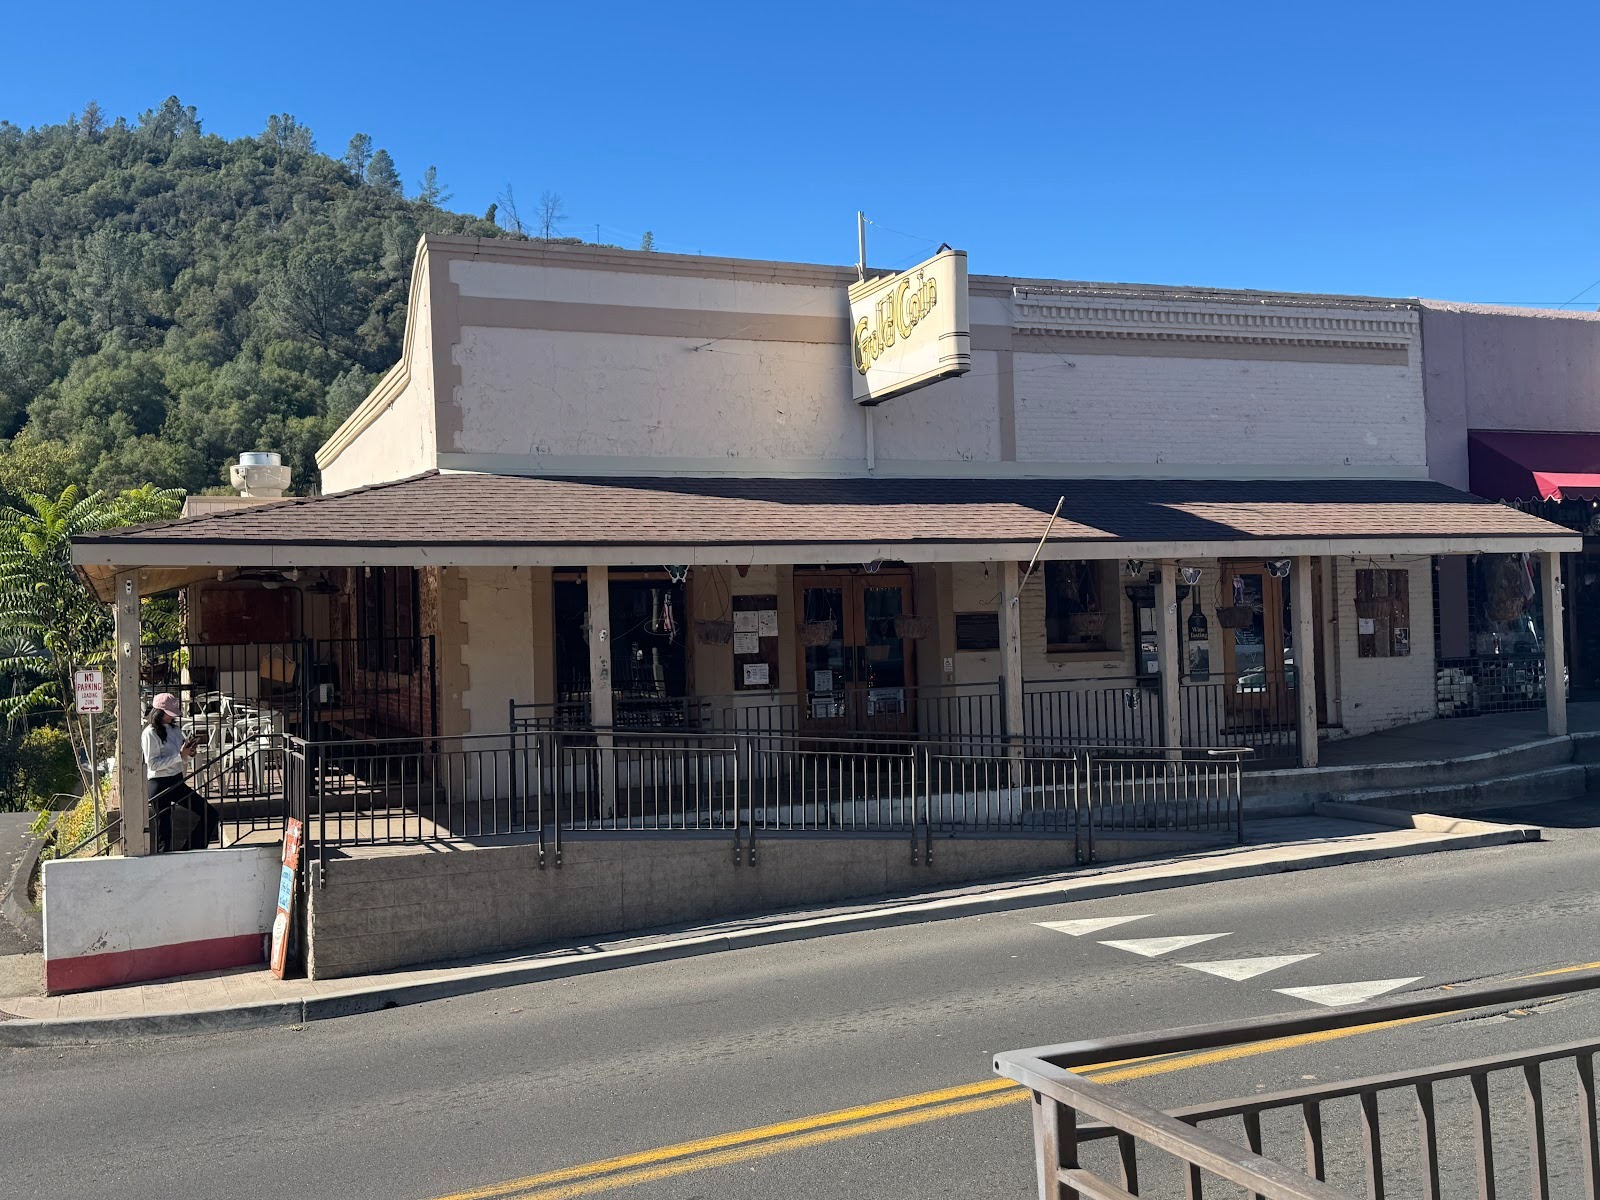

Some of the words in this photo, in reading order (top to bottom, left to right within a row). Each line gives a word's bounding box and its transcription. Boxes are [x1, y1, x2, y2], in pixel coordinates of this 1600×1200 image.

[853, 289, 895, 375] Gold
[896, 268, 938, 340] Coin
[84, 673, 94, 682] NO
[77, 682, 102, 691] PARKING
